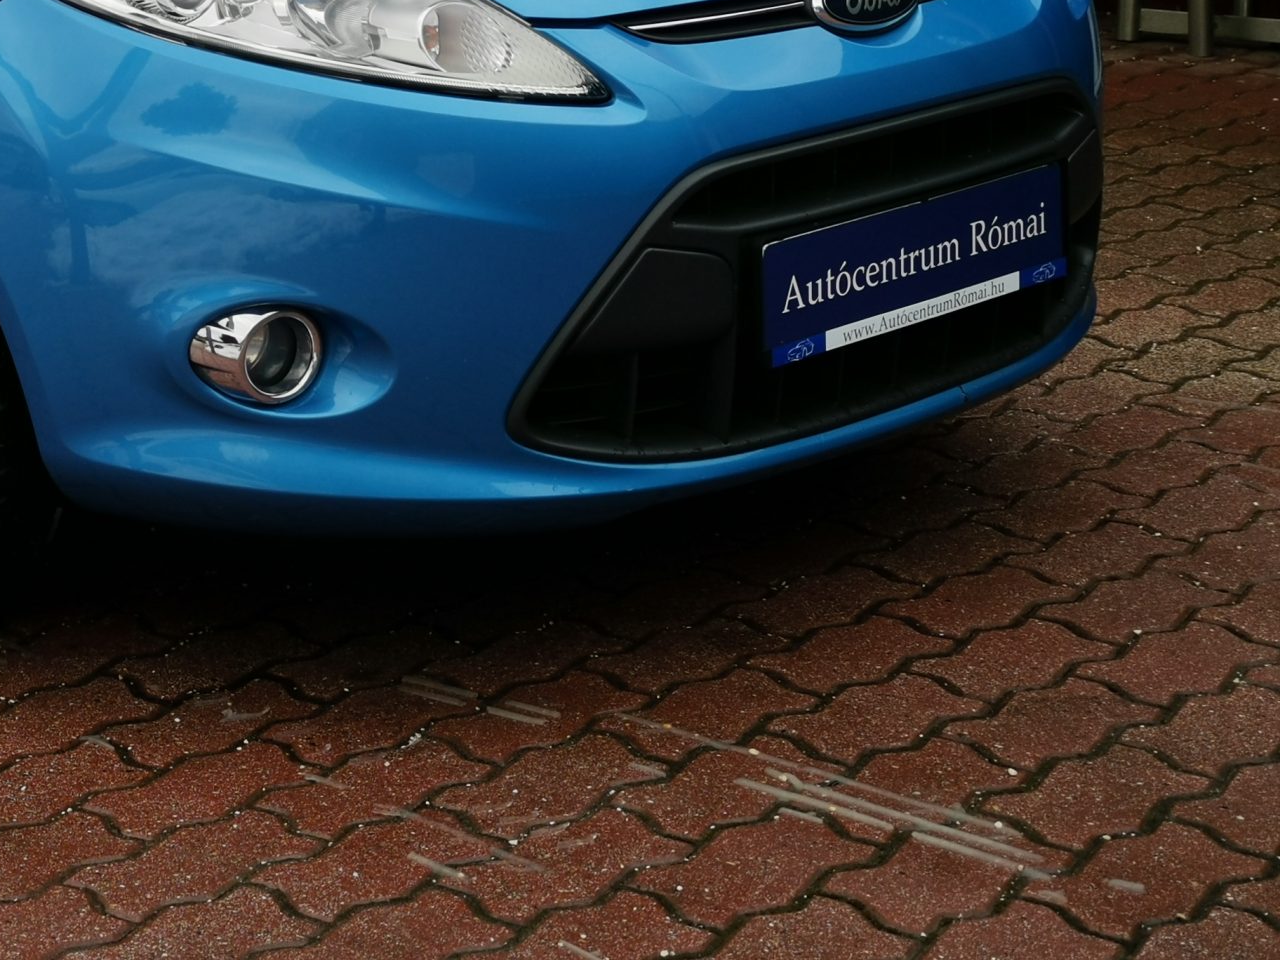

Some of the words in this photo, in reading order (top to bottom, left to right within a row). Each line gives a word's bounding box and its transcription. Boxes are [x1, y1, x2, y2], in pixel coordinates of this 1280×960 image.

[781, 238, 961, 314] Autócentrum
[969, 202, 1047, 257] Római
[842, 280, 1006, 344] www.AutócentrumRómai.hu
